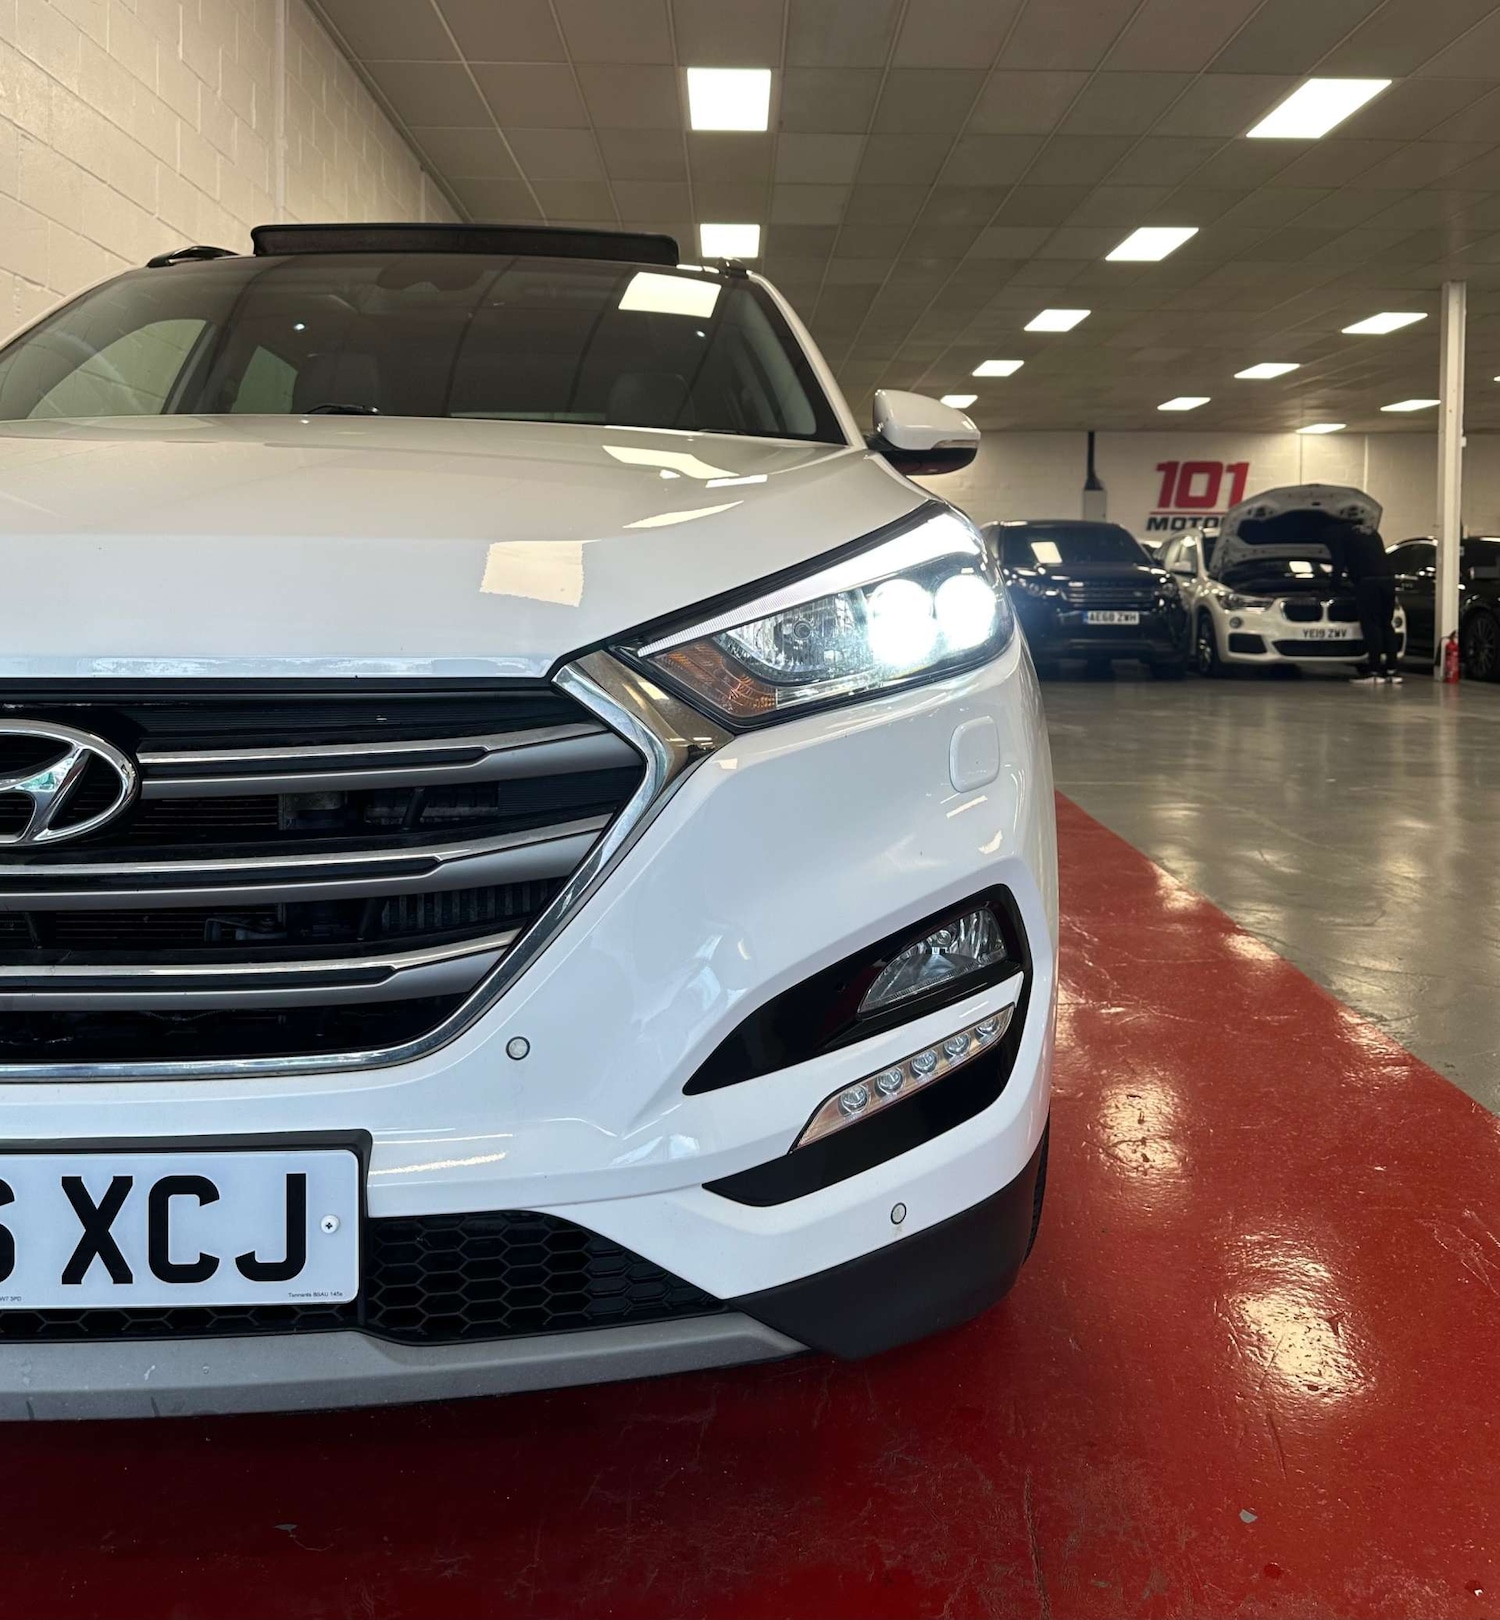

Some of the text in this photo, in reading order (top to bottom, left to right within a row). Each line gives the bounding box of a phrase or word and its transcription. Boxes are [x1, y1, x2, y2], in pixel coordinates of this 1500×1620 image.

[1156, 461, 1249, 508] 101
[1146, 517, 1224, 531] MOTO
[61, 1173, 307, 1285] XCJ
